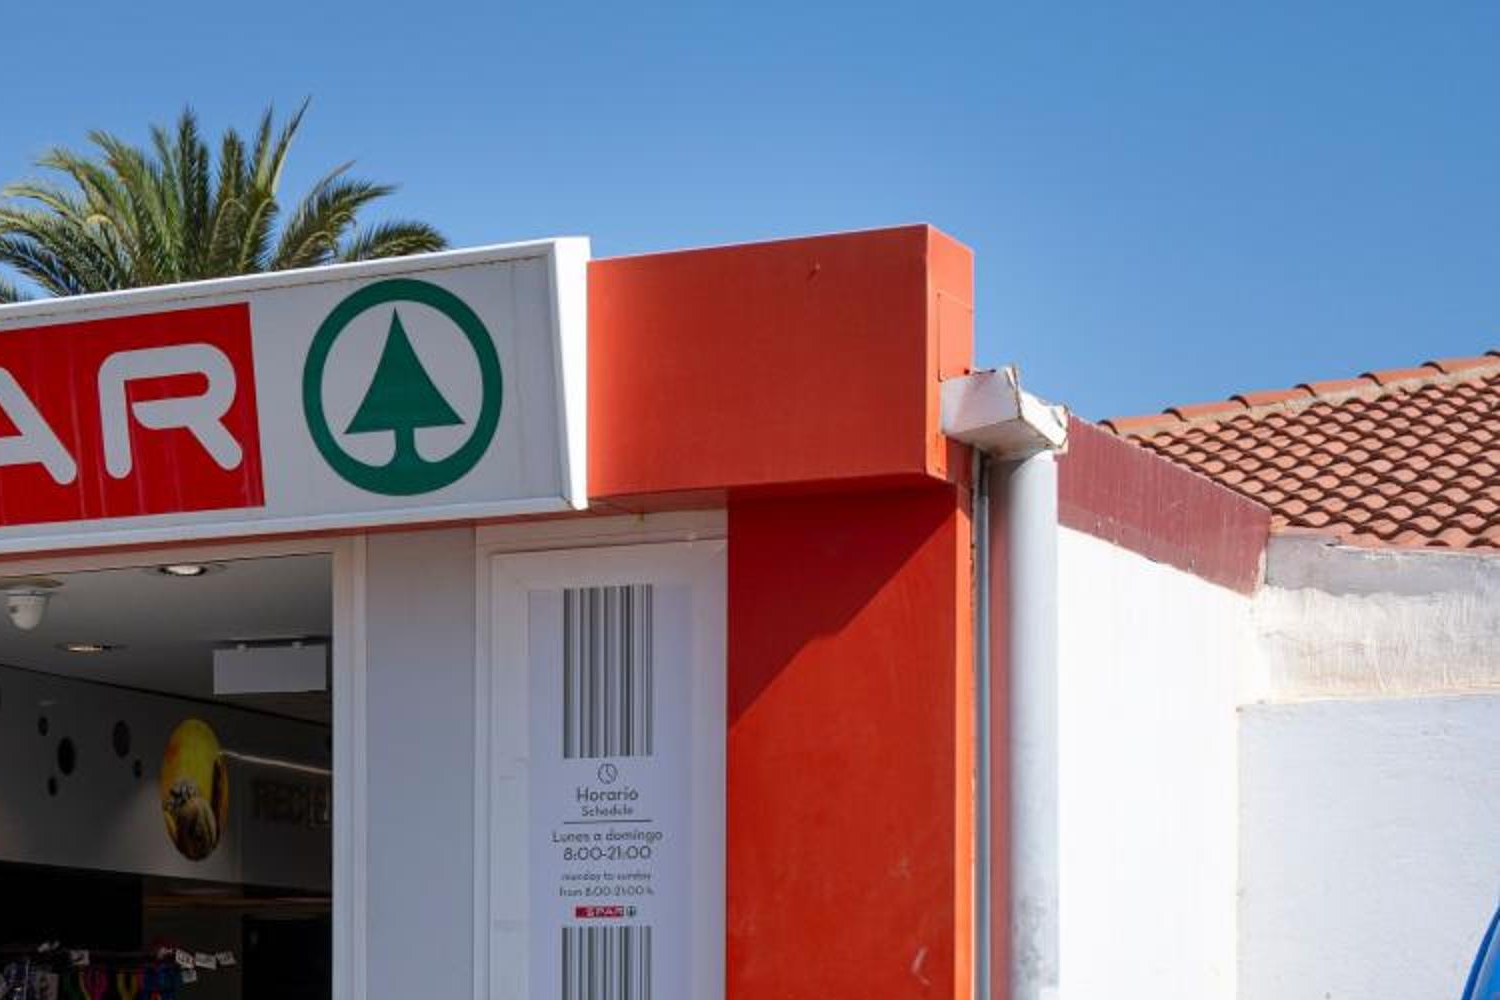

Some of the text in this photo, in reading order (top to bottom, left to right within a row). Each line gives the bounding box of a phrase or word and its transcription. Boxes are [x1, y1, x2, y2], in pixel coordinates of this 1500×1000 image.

[576, 785, 639, 802] Horario
[581, 803, 634, 817] Schedule
[552, 828, 663, 845] Lunes a domingo
[563, 845, 652, 861] 8:00-21:00
